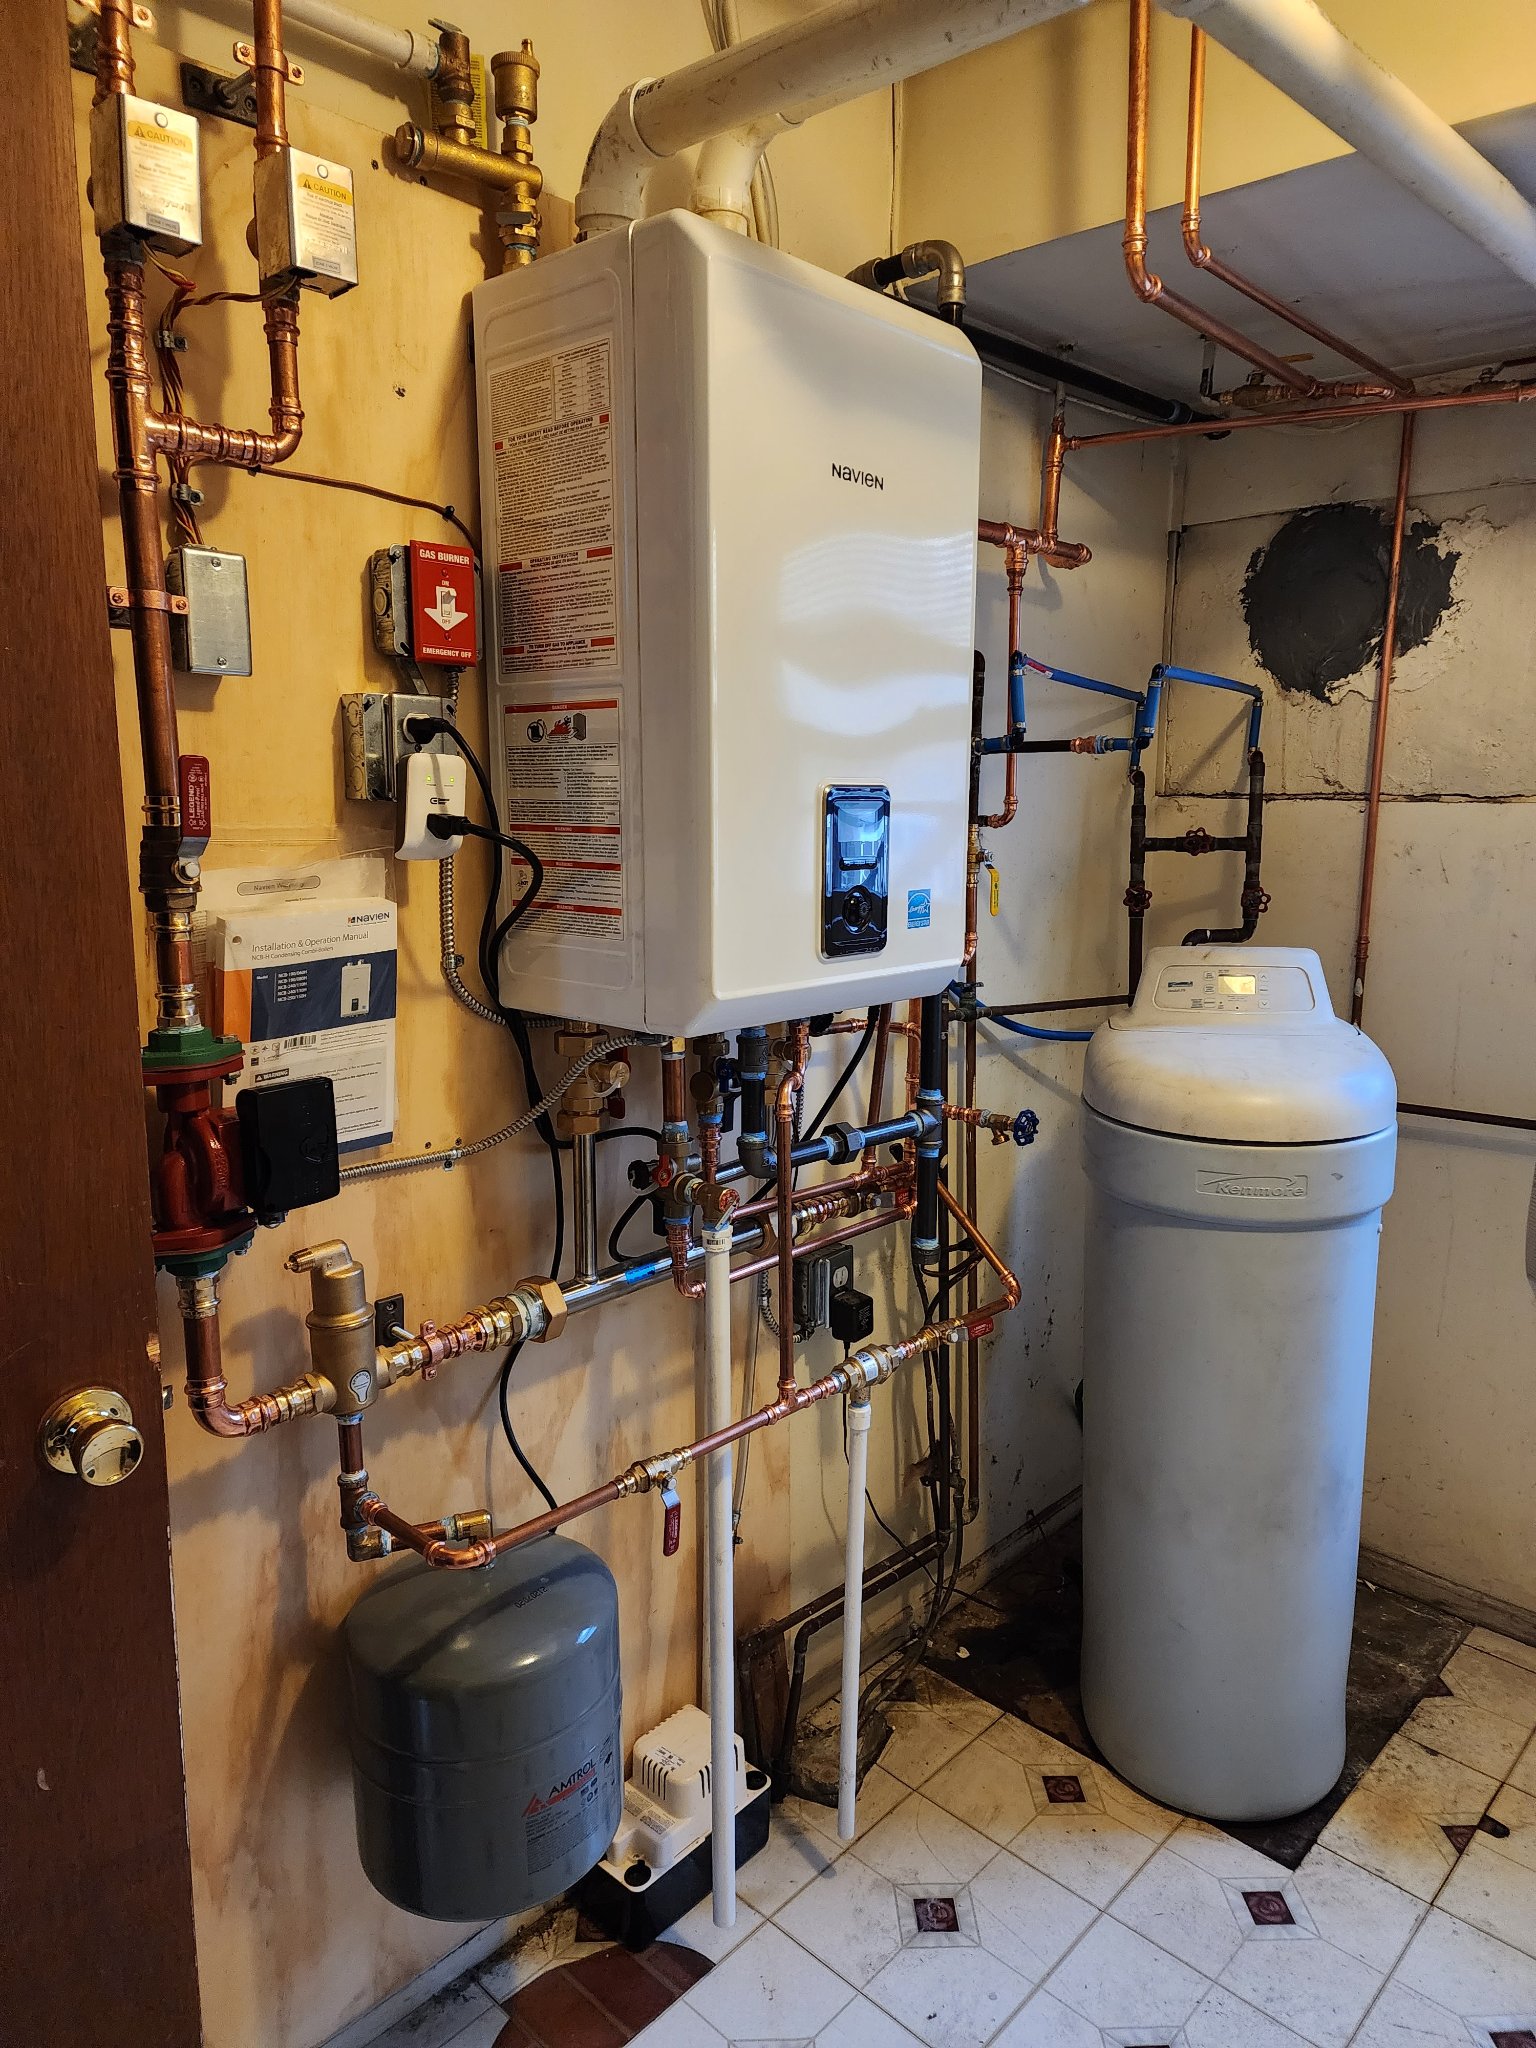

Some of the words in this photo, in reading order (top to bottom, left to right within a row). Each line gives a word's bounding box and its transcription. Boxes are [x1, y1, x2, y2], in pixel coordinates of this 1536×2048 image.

[147, 129, 186, 148] CAUTION
[313, 183, 347, 200] CAUTION
[419, 548, 436, 560] GAS
[437, 551, 470, 565] BURNER
[441, 579, 450, 587] ON
[422, 646, 459, 657] EMERGENCY
[460, 651, 472, 659] OFF
[252, 942, 296, 952] Installation
[298, 939, 304, 948] &
[304, 935, 341, 947] Operation
[342, 931, 369, 941] Manual
[270, 950, 301, 959] Condensing
[263, 1069, 289, 1081] WARNING
[1215, 1183, 1304, 1197] Kenmore
[549, 1758, 596, 1798] AMTROL
